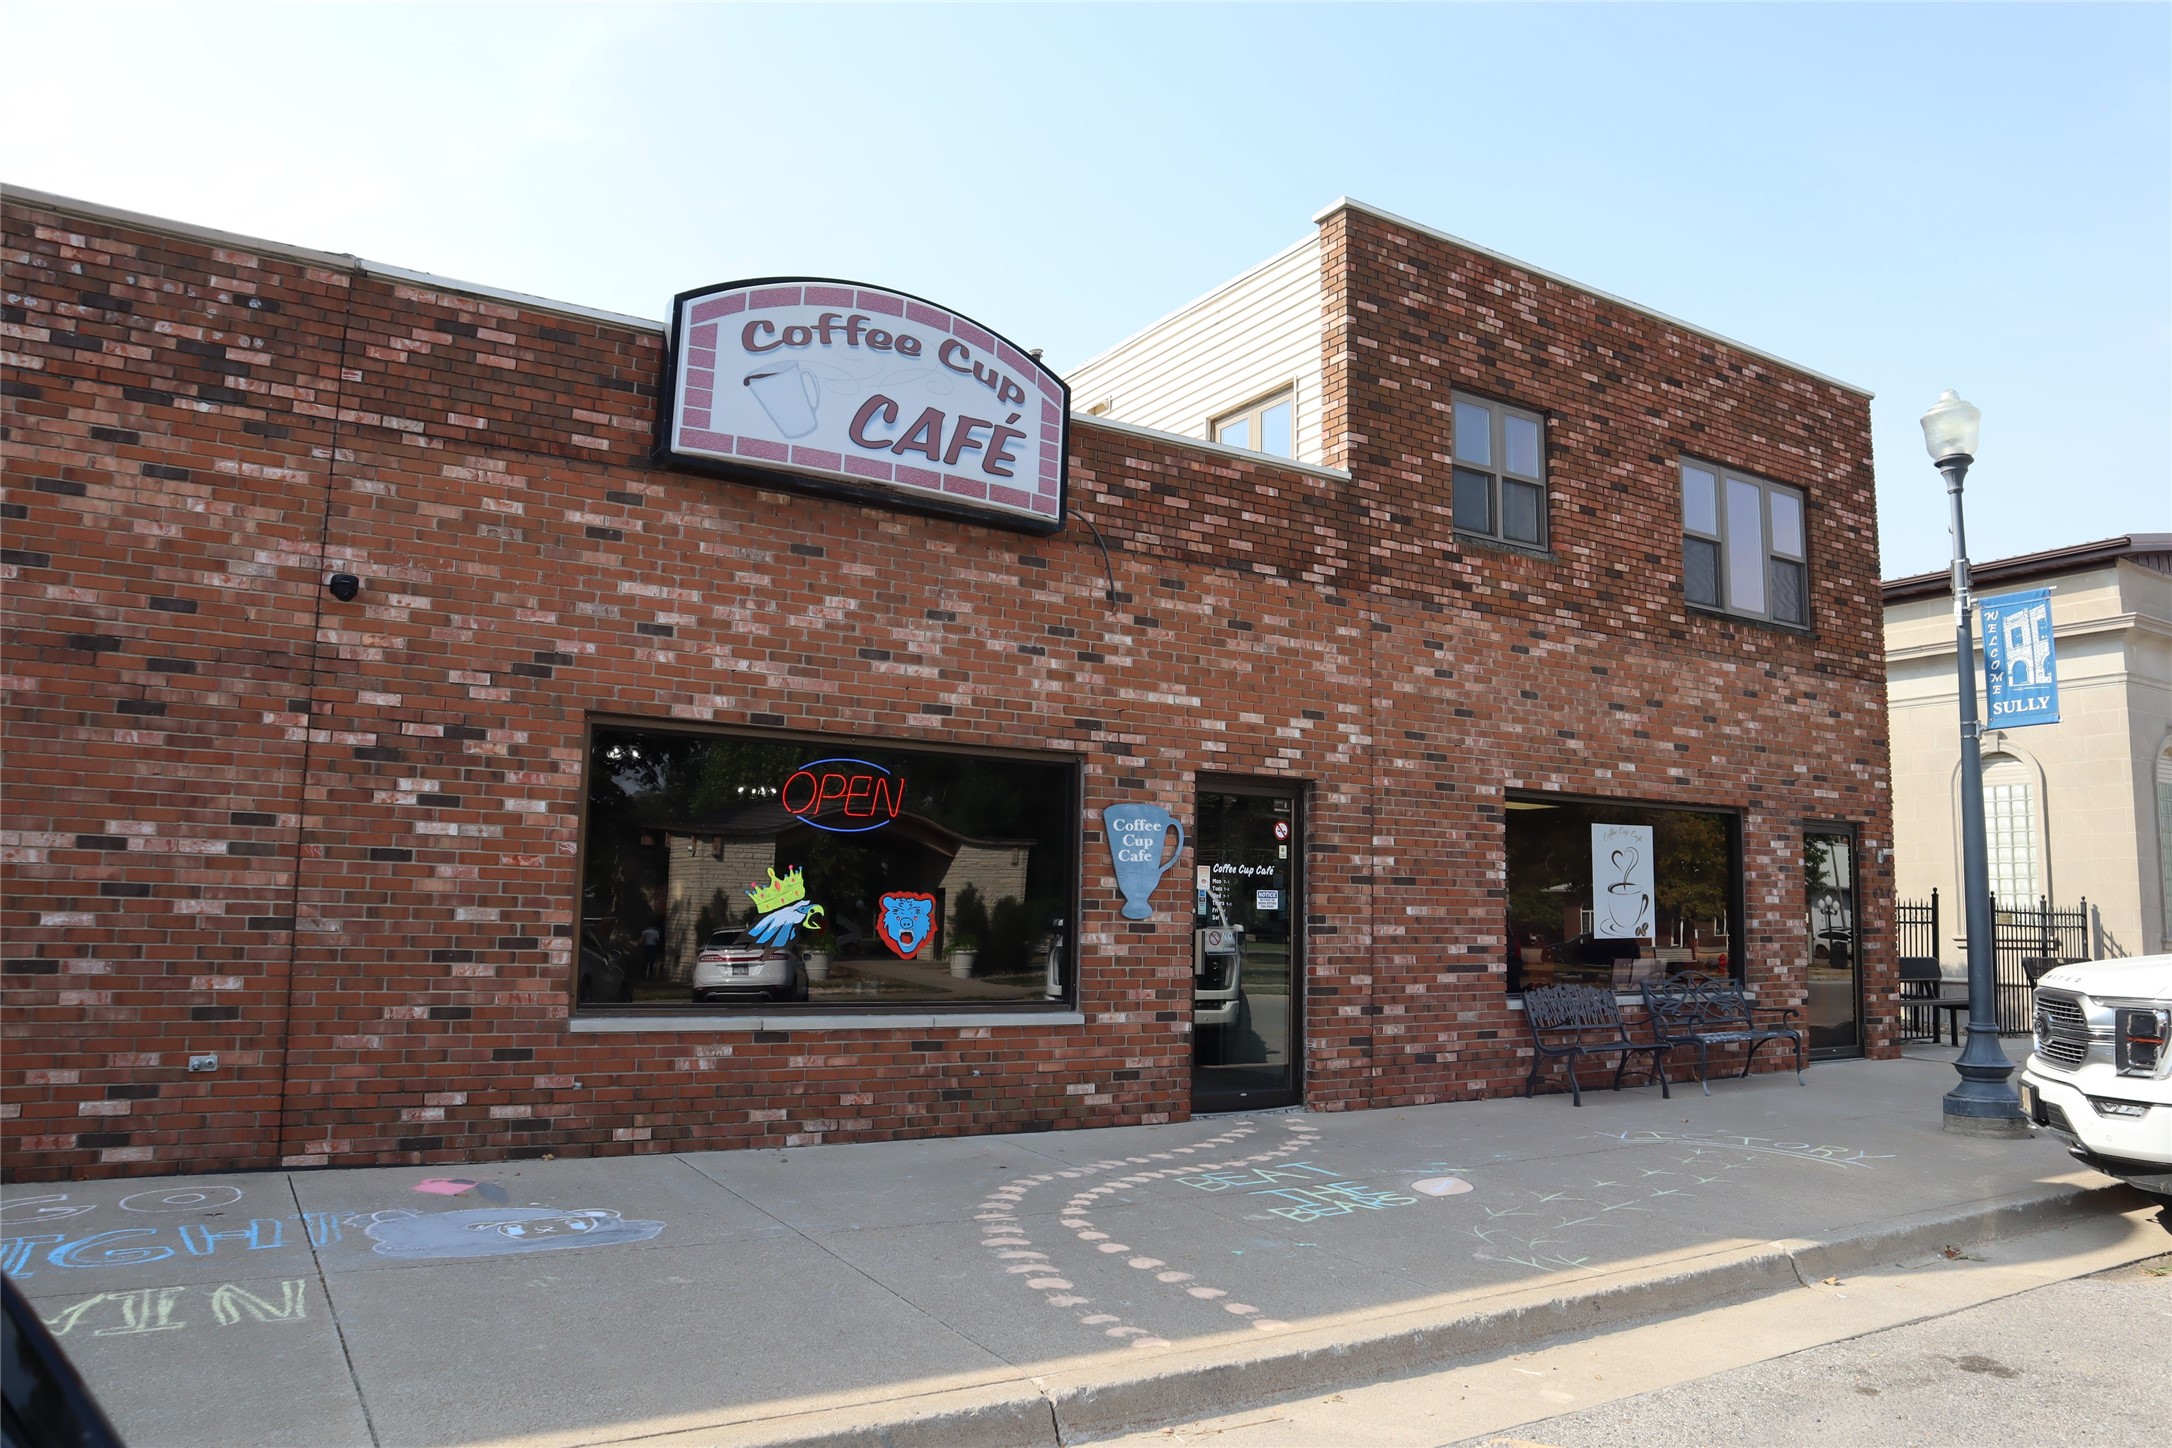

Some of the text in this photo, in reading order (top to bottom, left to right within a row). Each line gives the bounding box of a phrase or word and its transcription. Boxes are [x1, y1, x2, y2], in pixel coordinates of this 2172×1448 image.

[741, 312, 1026, 405] Coffee Cup
[848, 393, 1028, 478] CAFÉ
[1984, 610, 2004, 695] WELCOME
[1993, 696, 2050, 715] SULLY
[782, 770, 905, 818] OPEN
[1112, 818, 1161, 832] Coffee
[1118, 849, 1152, 862] Cafe
[1122, 833, 1154, 850] Cup
[1213, 863, 1275, 877] Coffee Cup Café
[1594, 1130, 1896, 1161] VICTORY
[1174, 1161, 1342, 1191] BEAT
[1266, 1191, 1418, 1222] BEARS
[43, 1279, 306, 1336] IN
